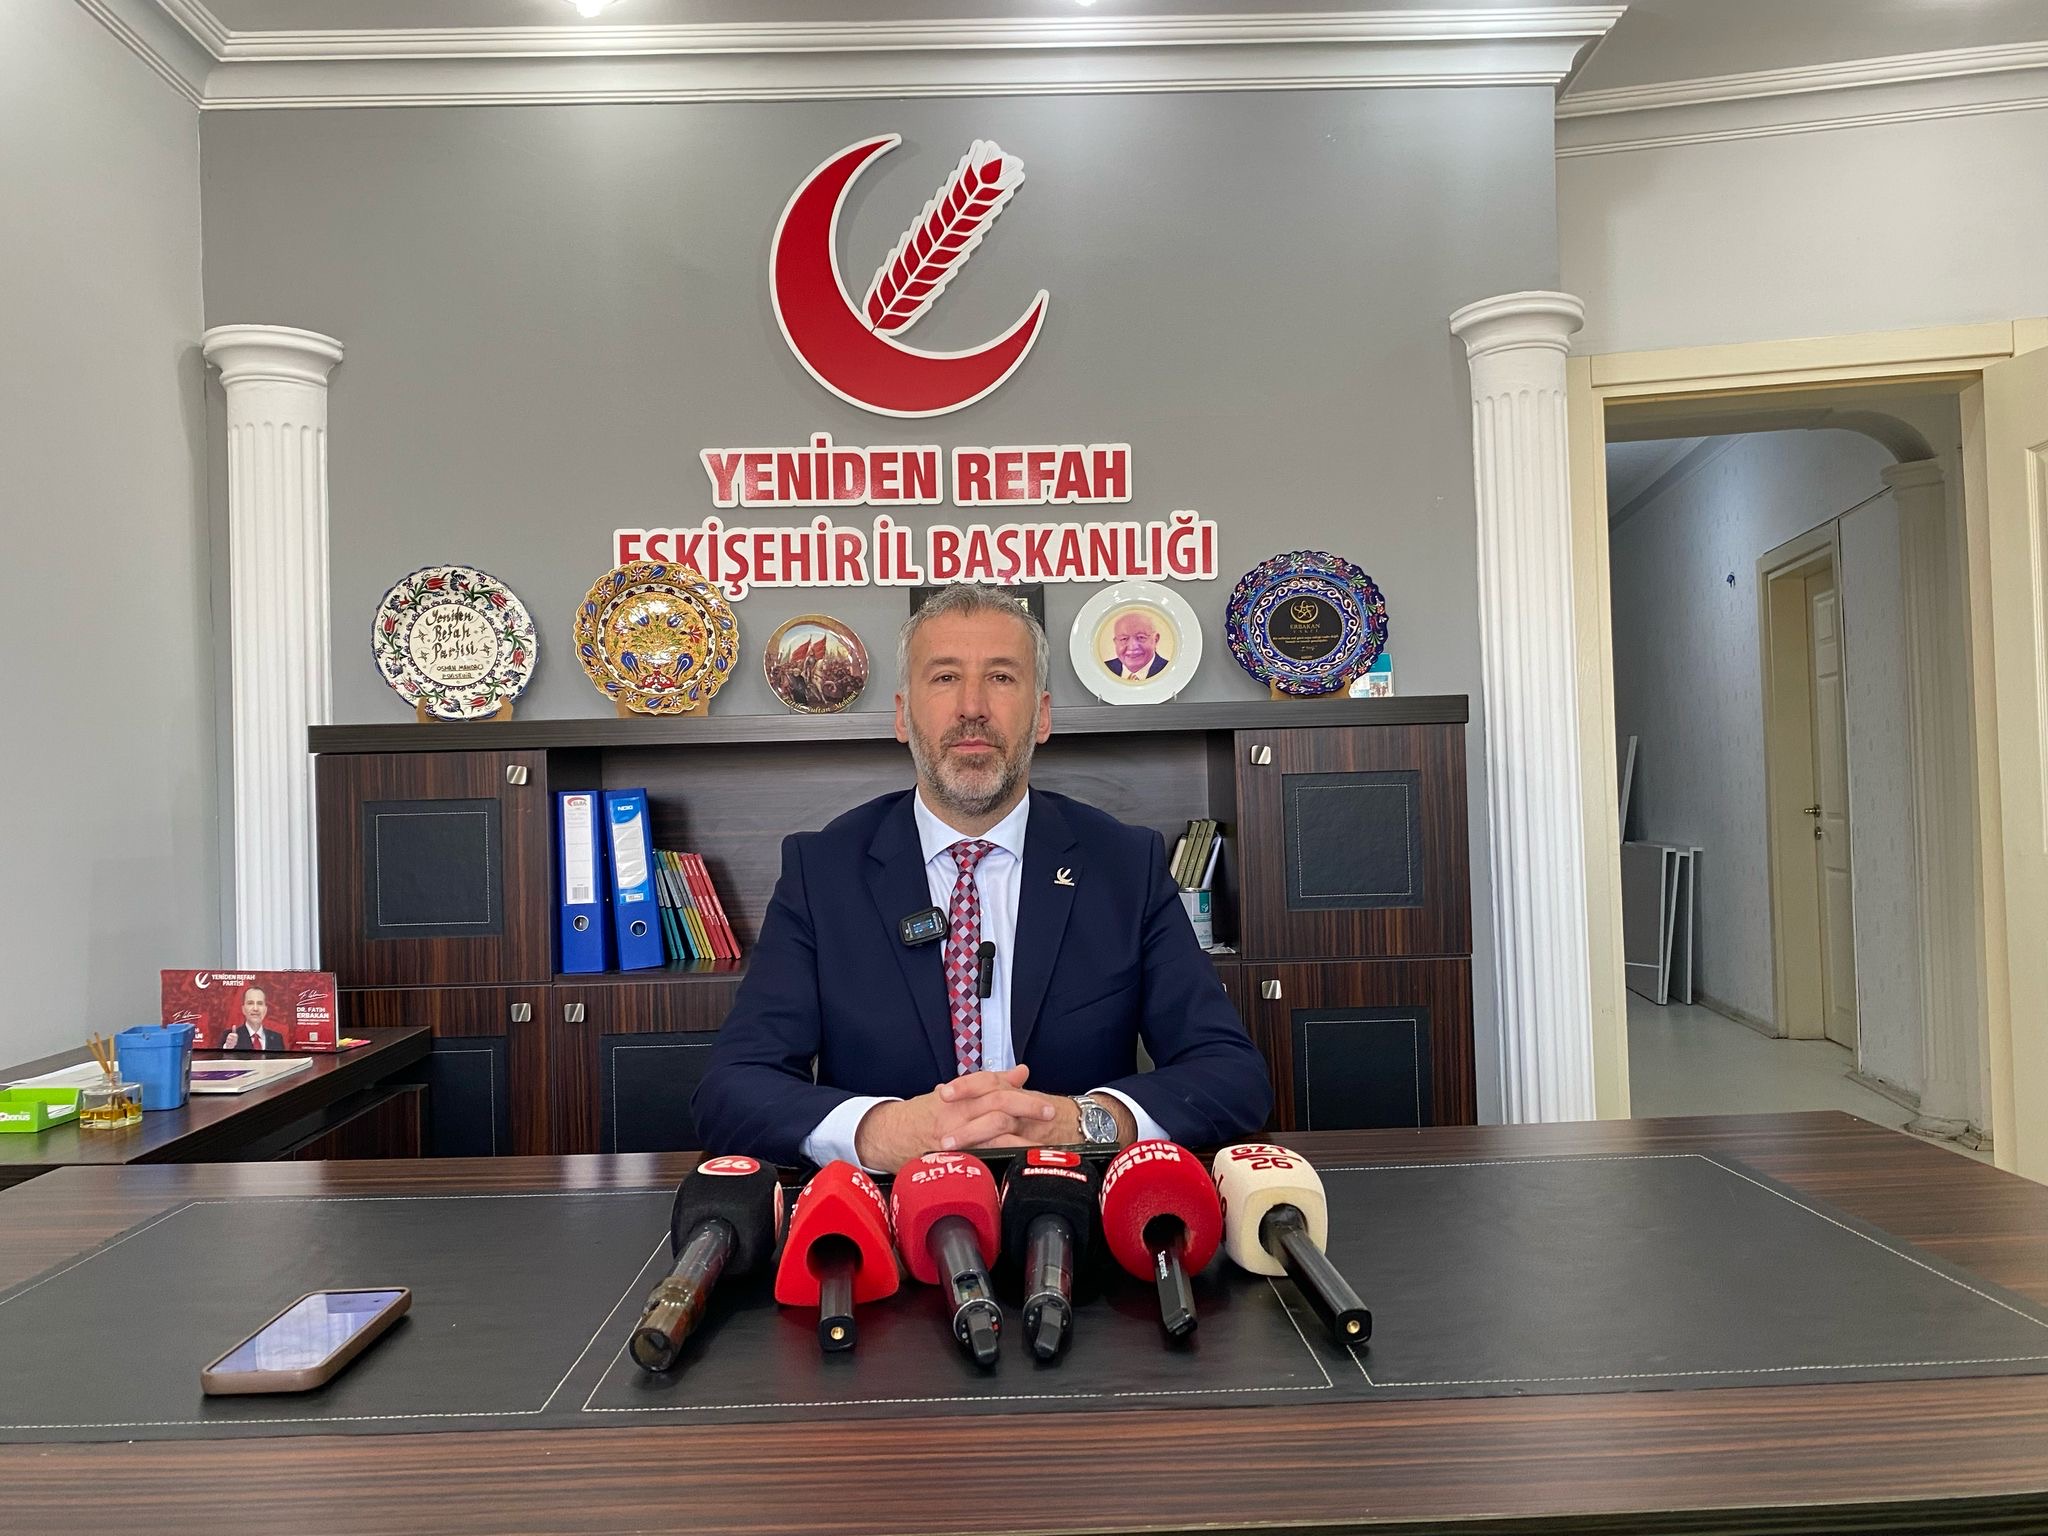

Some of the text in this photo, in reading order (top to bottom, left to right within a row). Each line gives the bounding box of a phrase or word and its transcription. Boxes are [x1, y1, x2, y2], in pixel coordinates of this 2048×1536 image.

[704, 437, 1128, 502] YENİDEN REFAH
[618, 514, 1213, 597] ESKİŞEHİR İL BAŞKANLIĞI
[712, 1158, 752, 1171] 26
[911, 1162, 982, 1183] anka
[1251, 1156, 1294, 1171] 26
